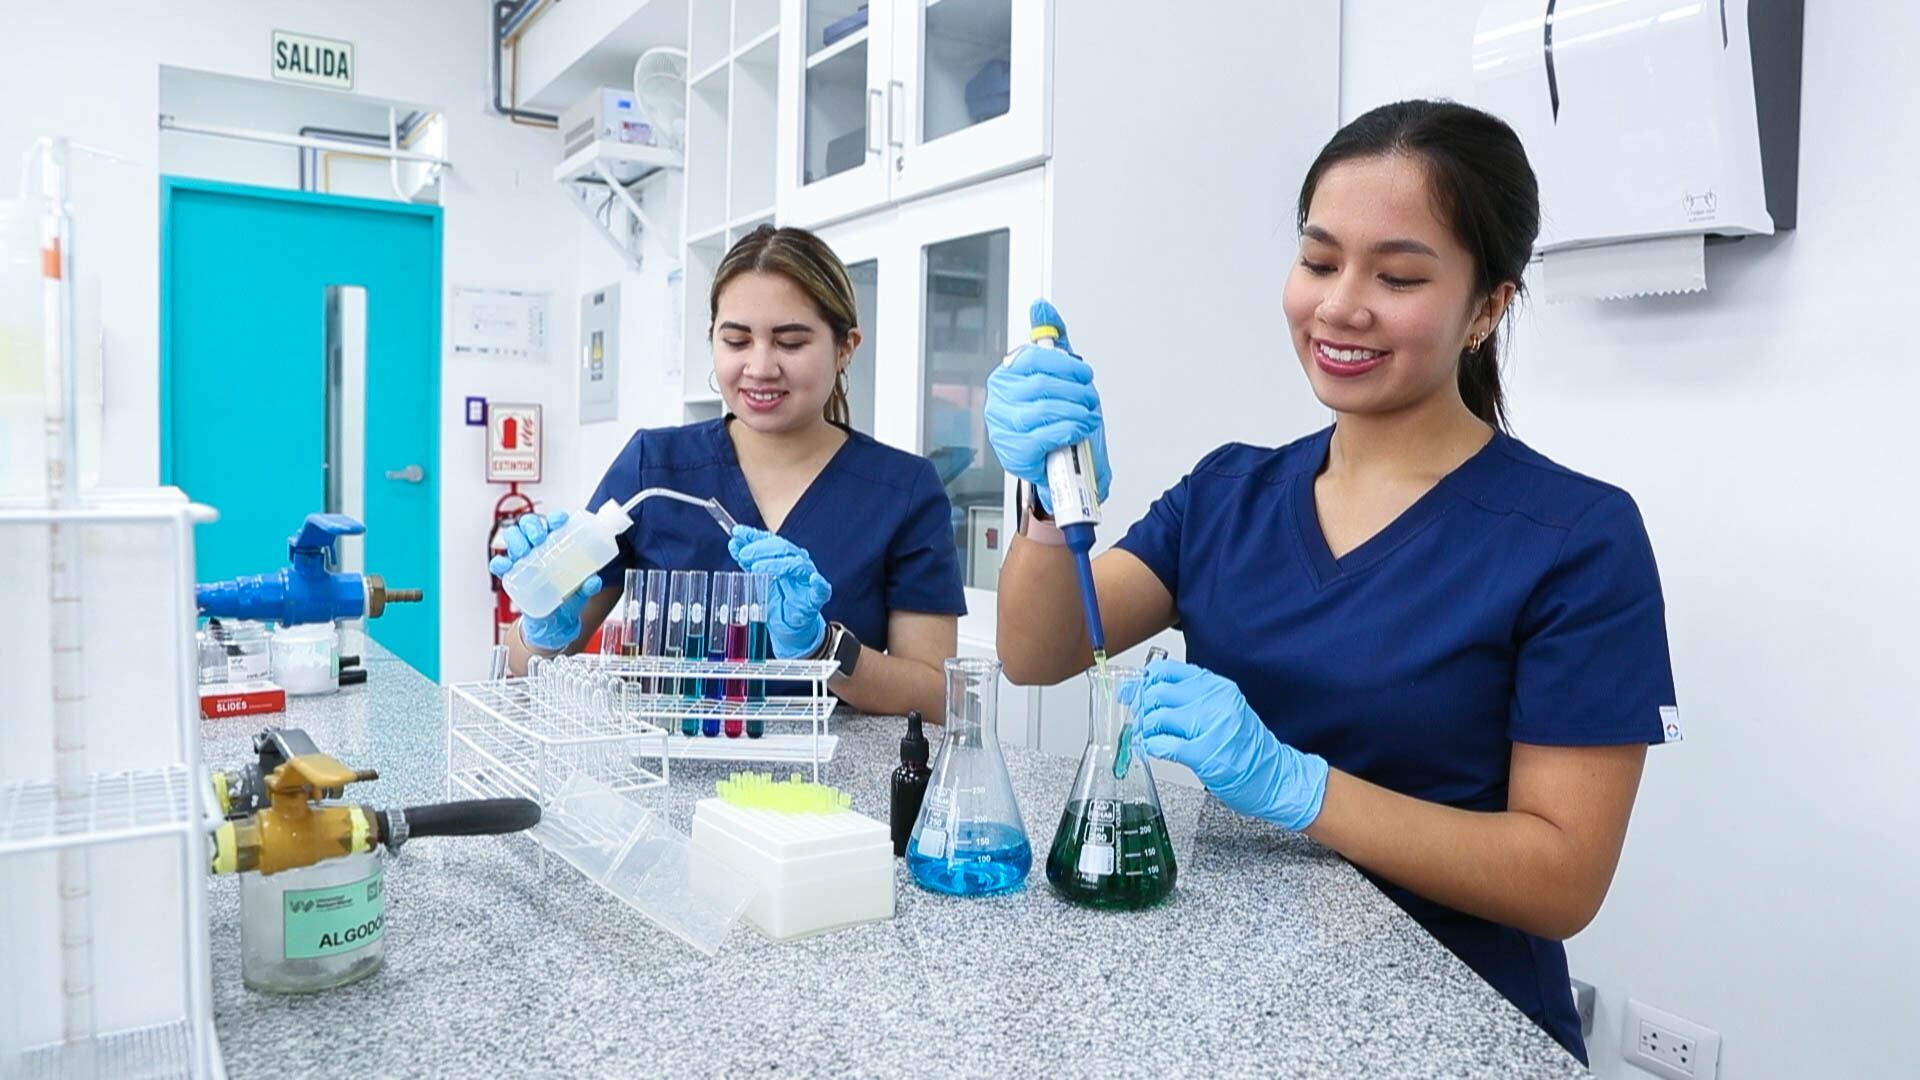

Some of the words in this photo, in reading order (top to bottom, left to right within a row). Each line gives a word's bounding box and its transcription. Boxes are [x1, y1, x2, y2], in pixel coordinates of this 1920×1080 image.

[276, 40, 349, 80] SALIDA
[216, 701, 248, 713] SLIDES
[974, 815, 987, 824] 200
[1140, 826, 1151, 834] 200
[976, 838, 990, 846] 150
[1144, 848, 1155, 856] 150
[977, 855, 991, 864] 100
[1147, 866, 1159, 874] 100
[319, 913, 384, 949] ALGODÓ
